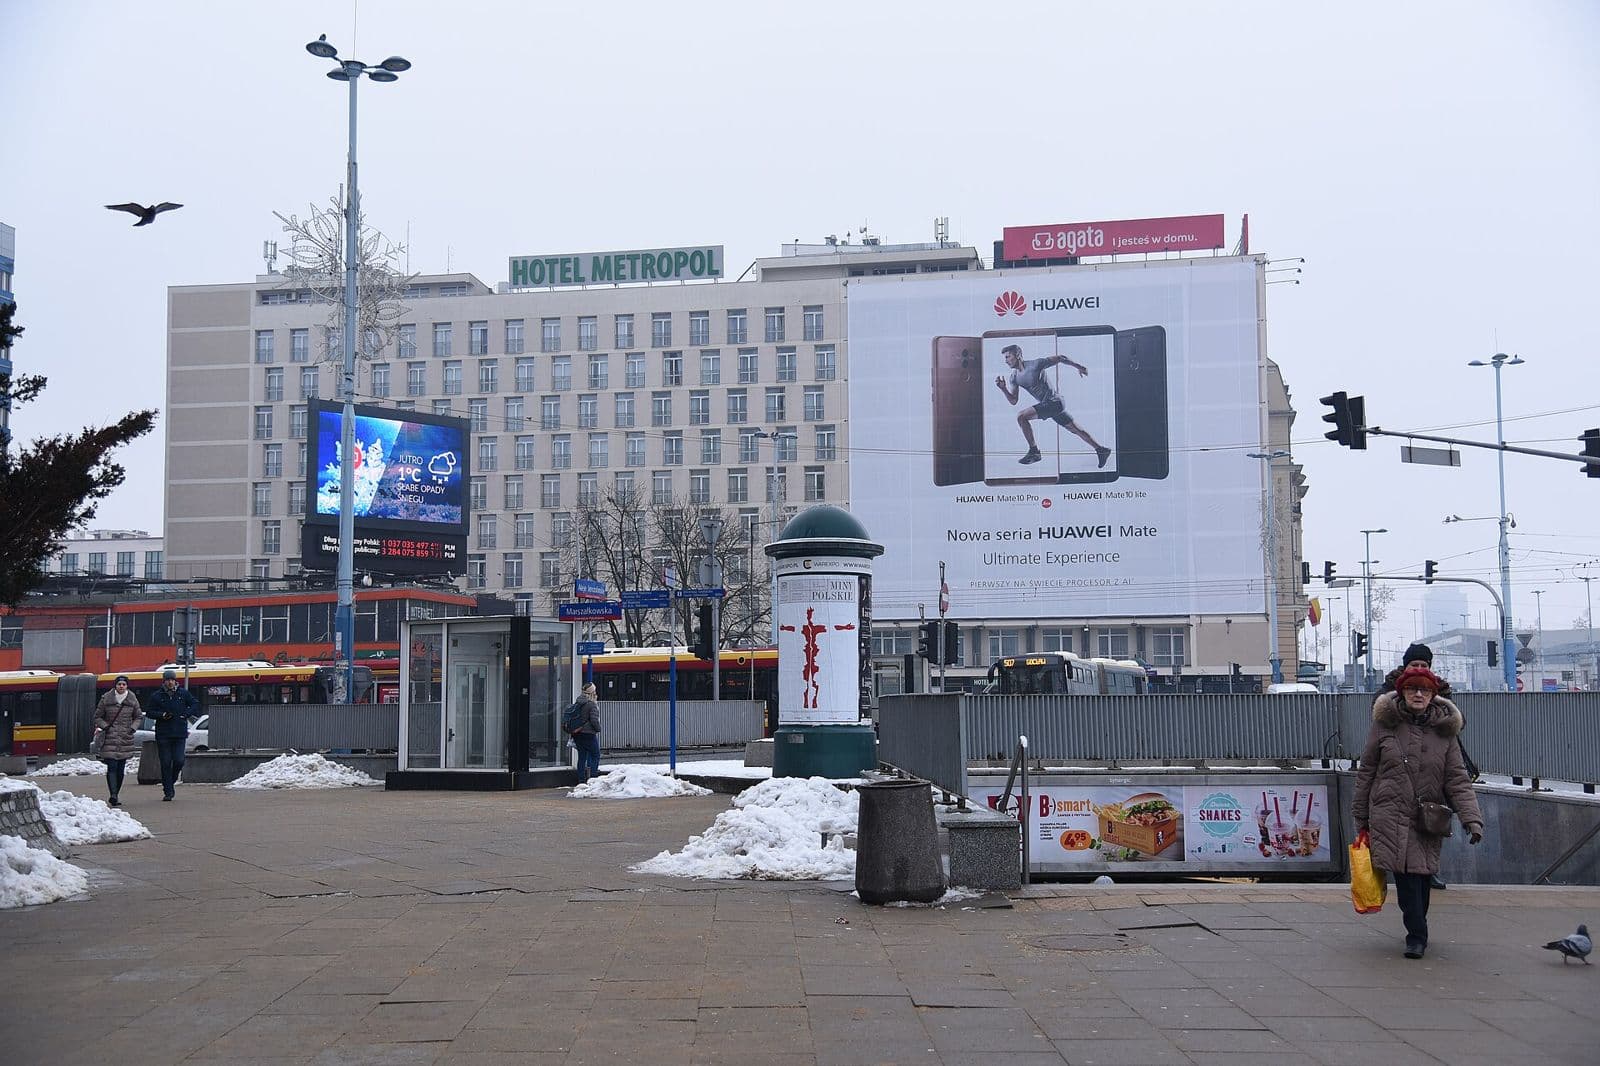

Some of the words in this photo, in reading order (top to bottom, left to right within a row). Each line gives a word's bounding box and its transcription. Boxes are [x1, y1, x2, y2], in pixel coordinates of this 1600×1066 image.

[1057, 226, 1104, 254] agata
[1116, 235, 1149, 248] jesteś
[1152, 235, 1161, 243] w
[1163, 233, 1198, 243] domu.
[512, 256, 585, 286] HOTEL
[592, 249, 719, 282] METROPOL
[1033, 296, 1100, 311] HUAWEI
[399, 455, 423, 464] JUTRO
[399, 467, 421, 482] 1°C
[421, 485, 445, 494] OPADY
[1063, 492, 1102, 500] HUAWEI
[1135, 490, 1147, 498] lite
[956, 495, 994, 503] HUAWEI
[947, 529, 991, 541] Nowa
[996, 528, 1032, 540] seria
[1038, 525, 1112, 540] HUAWEI
[1120, 525, 1157, 538] Mate
[444, 551, 456, 559] PLN
[983, 552, 1041, 565] Ultimate
[1046, 551, 1120, 566] Experience
[831, 581, 852, 590] MINY
[970, 581, 1011, 589] PIERWSZY
[1014, 580, 1026, 588] NA
[1066, 578, 1111, 587] PROCESOR
[1114, 578, 1119, 586] Z
[812, 591, 853, 600] POLSKIE
[167, 624, 251, 637] IERNET
[1003, 659, 1015, 667] 507
[1057, 799, 1091, 812] smart
[1199, 809, 1241, 821] SHAKES
